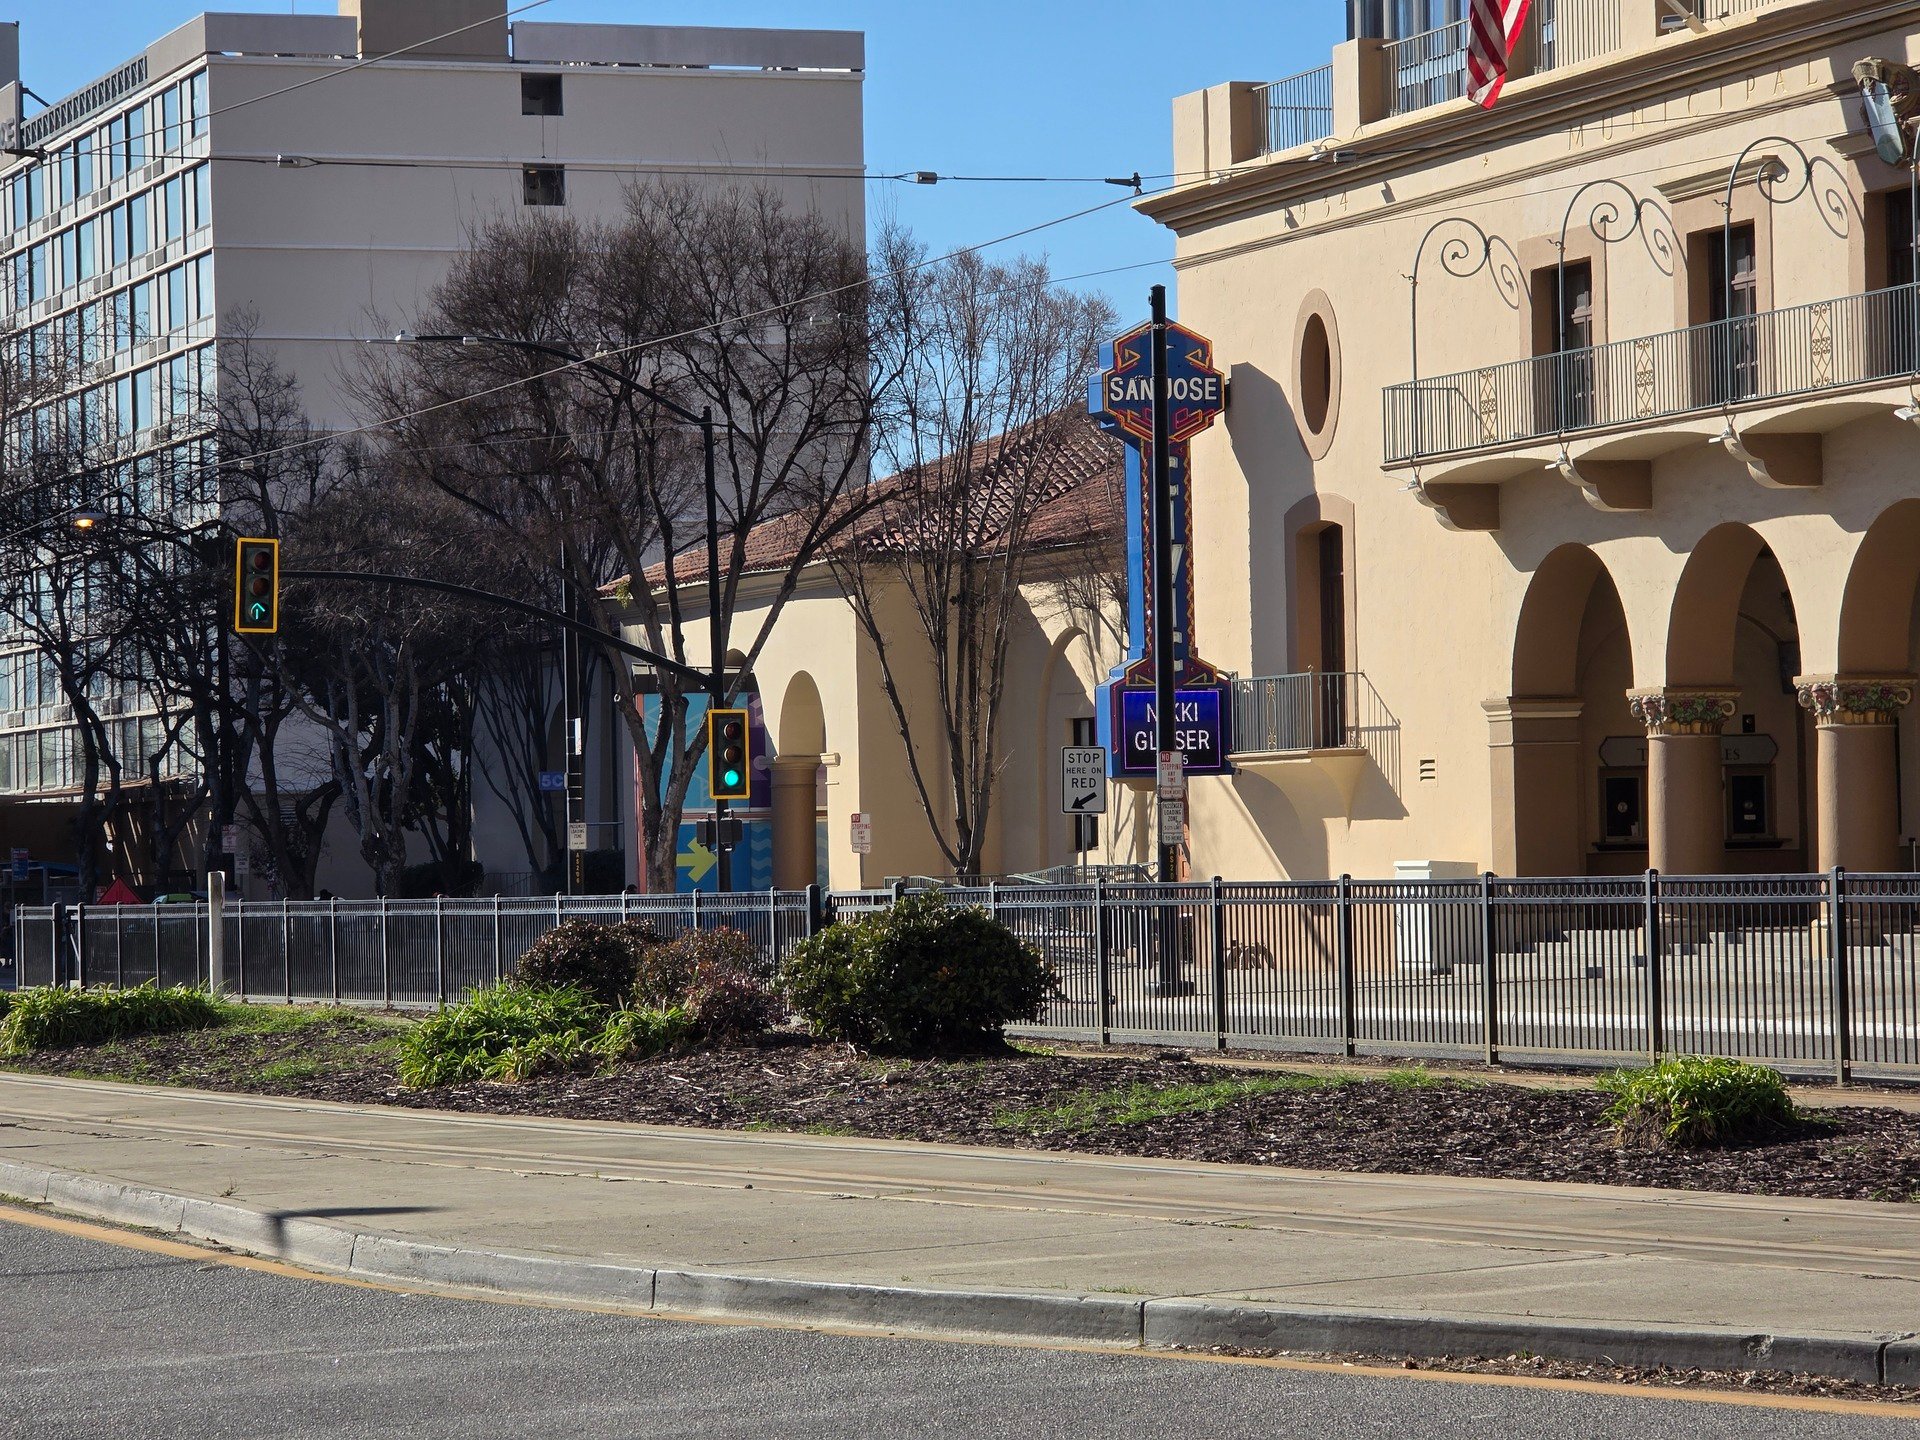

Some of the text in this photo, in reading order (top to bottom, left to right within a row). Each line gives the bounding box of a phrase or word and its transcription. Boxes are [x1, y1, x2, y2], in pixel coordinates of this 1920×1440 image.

[1567, 57, 1820, 152] MUNICIPAL
[1283, 187, 1349, 228] 1934
[1110, 377, 1154, 401] SAN
[1147, 702, 1199, 722] NKI
[1135, 730, 1210, 750] GLSER
[1068, 753, 1100, 764] STOP
[1161, 753, 1170, 762] NO
[1091, 766, 1102, 774] ON
[1071, 777, 1097, 788] RED
